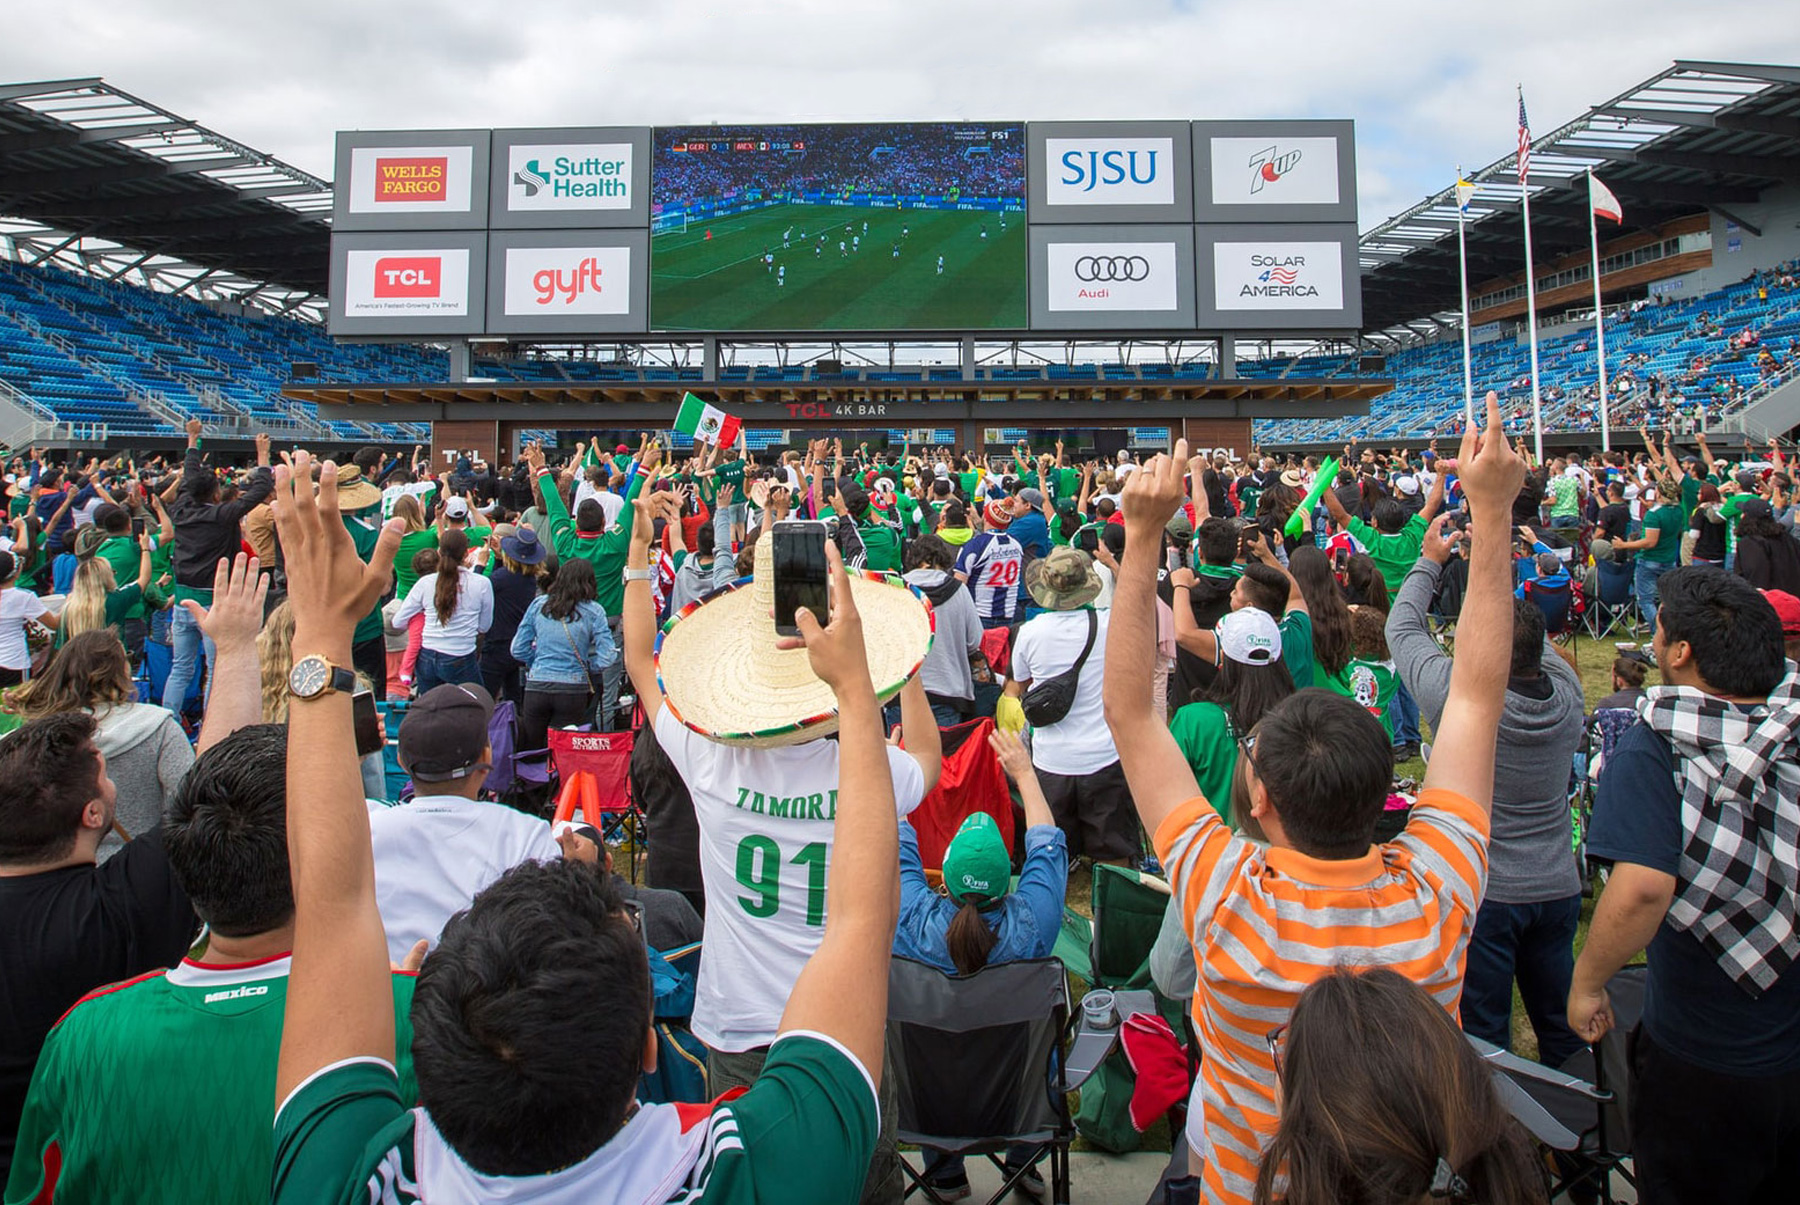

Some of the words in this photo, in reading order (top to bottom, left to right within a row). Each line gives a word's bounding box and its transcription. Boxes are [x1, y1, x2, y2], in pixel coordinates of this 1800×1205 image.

[992, 131, 1009, 140] FS1
[382, 165, 442, 178] WELLS
[554, 157, 625, 176] Sutter
[1061, 150, 1158, 192] SJSU
[382, 181, 441, 194] FARGO
[554, 178, 626, 197] Health
[1251, 255, 1305, 267] SOLAR
[383, 269, 432, 286] TCL
[533, 257, 602, 305] gyft
[1258, 270, 1271, 283] 4
[1078, 288, 1109, 298] Audi
[1239, 284, 1319, 297] AMERICA
[785, 403, 831, 418] TCL
[836, 404, 853, 415] 4K
[858, 404, 886, 415] BAR
[985, 558, 1019, 587] 20
[572, 737, 610, 746] SPORTS
[735, 834, 827, 926] 91
